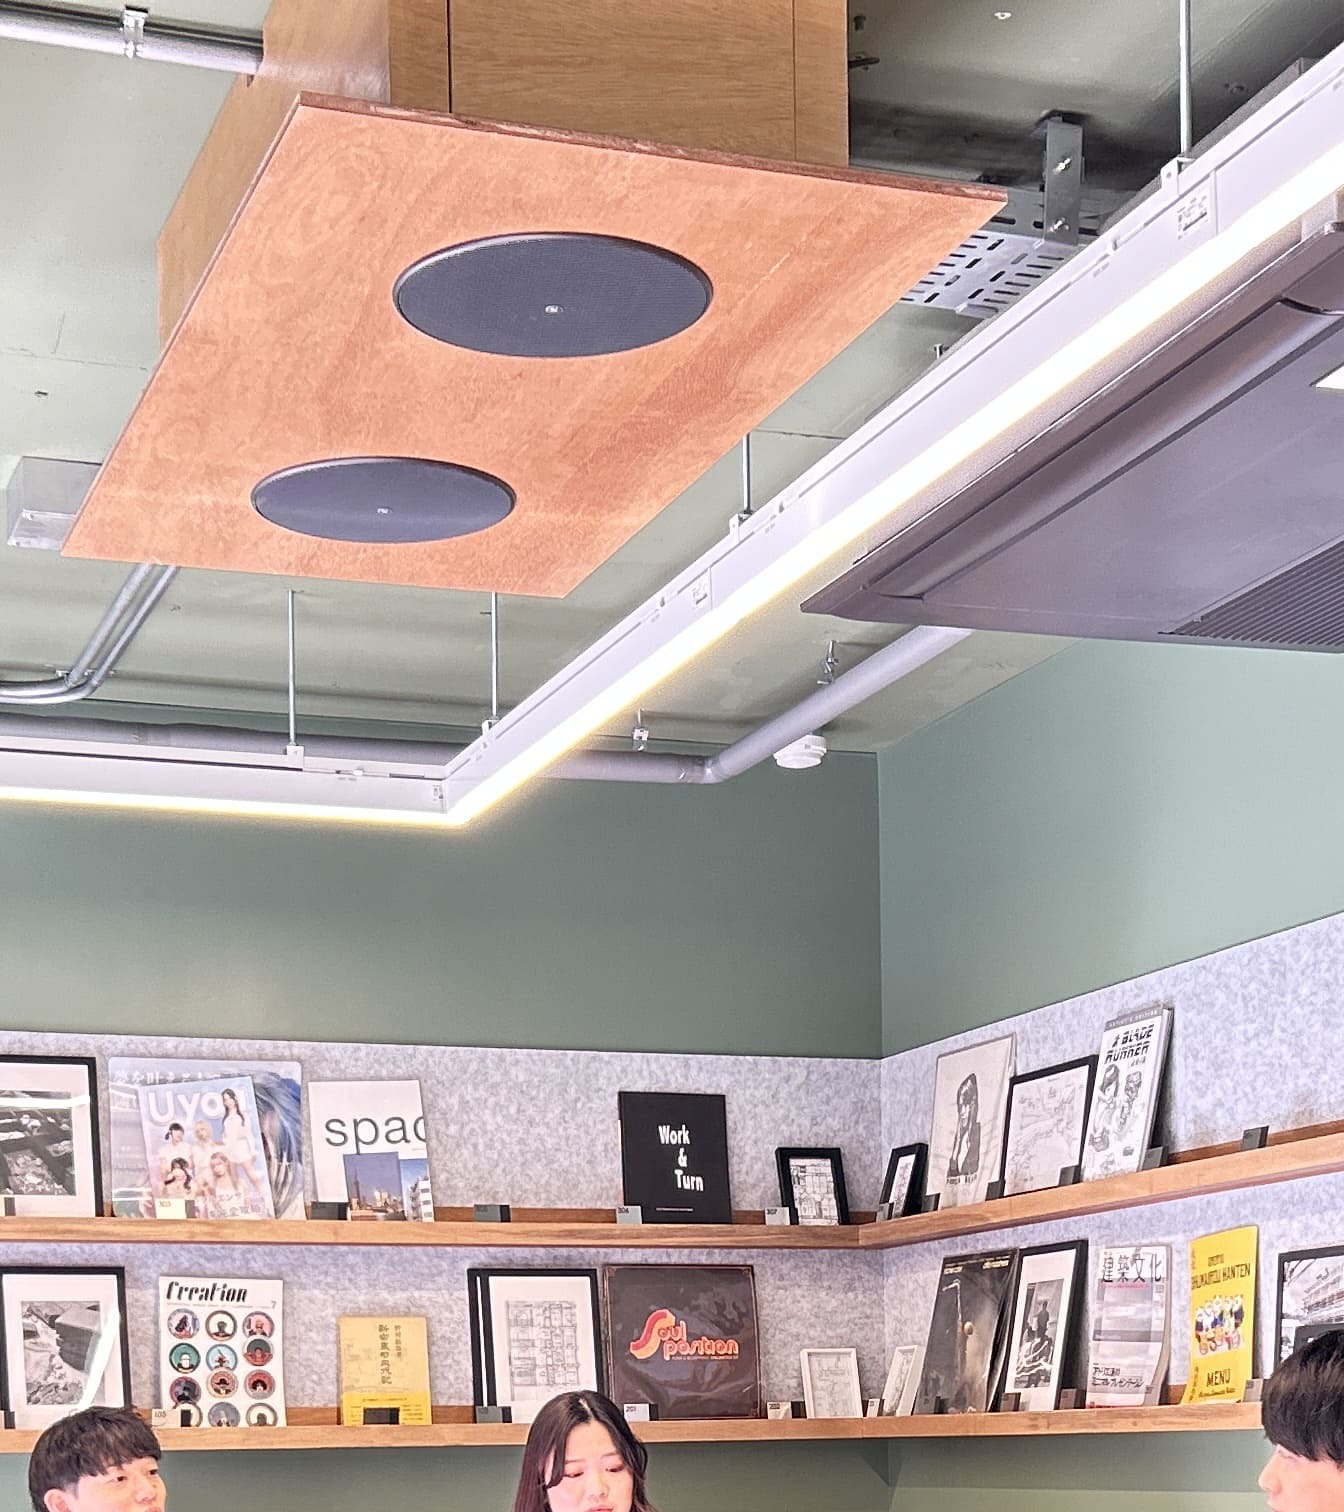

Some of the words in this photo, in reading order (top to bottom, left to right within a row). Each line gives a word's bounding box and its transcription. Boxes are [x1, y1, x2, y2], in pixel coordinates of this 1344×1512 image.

[658, 1124, 691, 1145] Work
[677, 1147, 687, 1168] &
[674, 1169, 704, 1192] Turn
[630, 1309, 686, 1359] Soul
[1206, 1368, 1231, 1387] MENU
